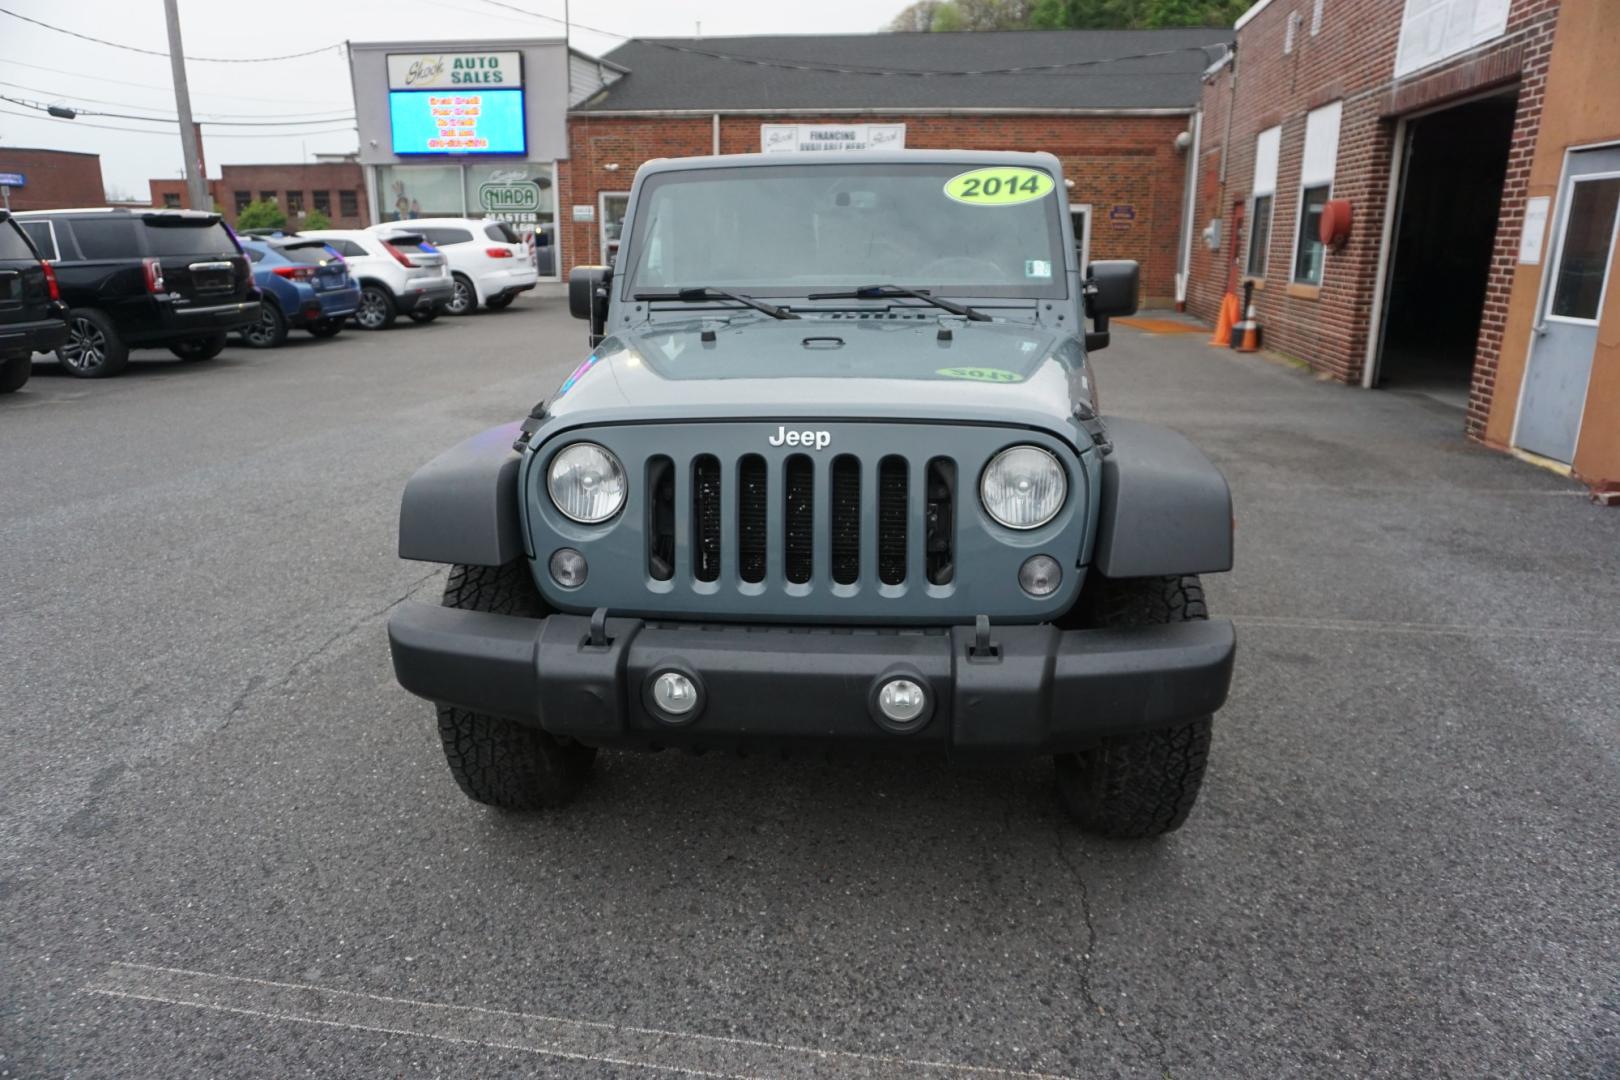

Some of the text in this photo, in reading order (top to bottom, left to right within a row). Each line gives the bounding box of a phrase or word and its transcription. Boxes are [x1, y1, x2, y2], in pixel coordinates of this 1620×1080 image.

[453, 57, 499, 69] AUTO
[451, 71, 503, 84] SALES
[810, 131, 855, 140] FINANCING
[960, 175, 1039, 197] 2014
[485, 189, 533, 204] NIADA
[485, 212, 537, 222] MASTER
[769, 426, 831, 450] Jeep
